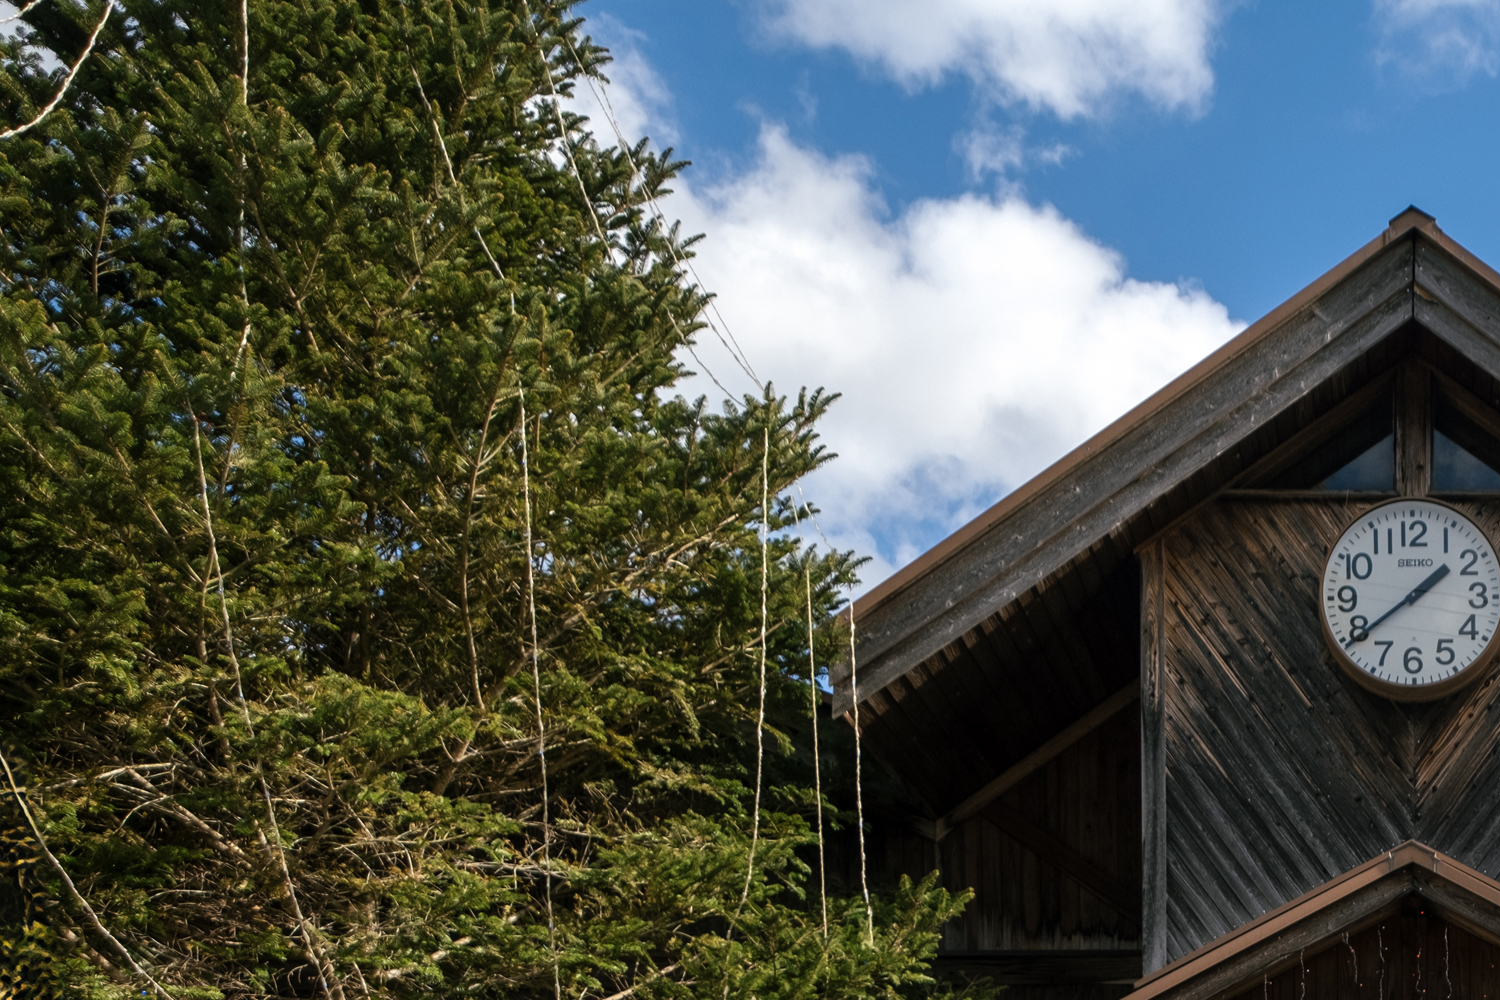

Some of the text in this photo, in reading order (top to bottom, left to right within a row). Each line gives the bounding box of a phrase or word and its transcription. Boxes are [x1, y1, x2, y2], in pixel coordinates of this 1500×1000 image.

[1373, 528, 1393, 555] 11
[1401, 520, 1428, 547] 12
[1443, 527, 1449, 554] 1
[1346, 552, 1373, 580] 10
[1398, 558, 1433, 568] SEIKO
[1459, 549, 1479, 576] 2
[1337, 585, 1358, 613] 9
[1468, 582, 1489, 609] 3
[1349, 615, 1370, 642] 8
[1458, 614, 1479, 640] 4
[1374, 640, 1394, 667] 7
[1402, 647, 1423, 674] 6
[1435, 638, 1456, 665] 5
